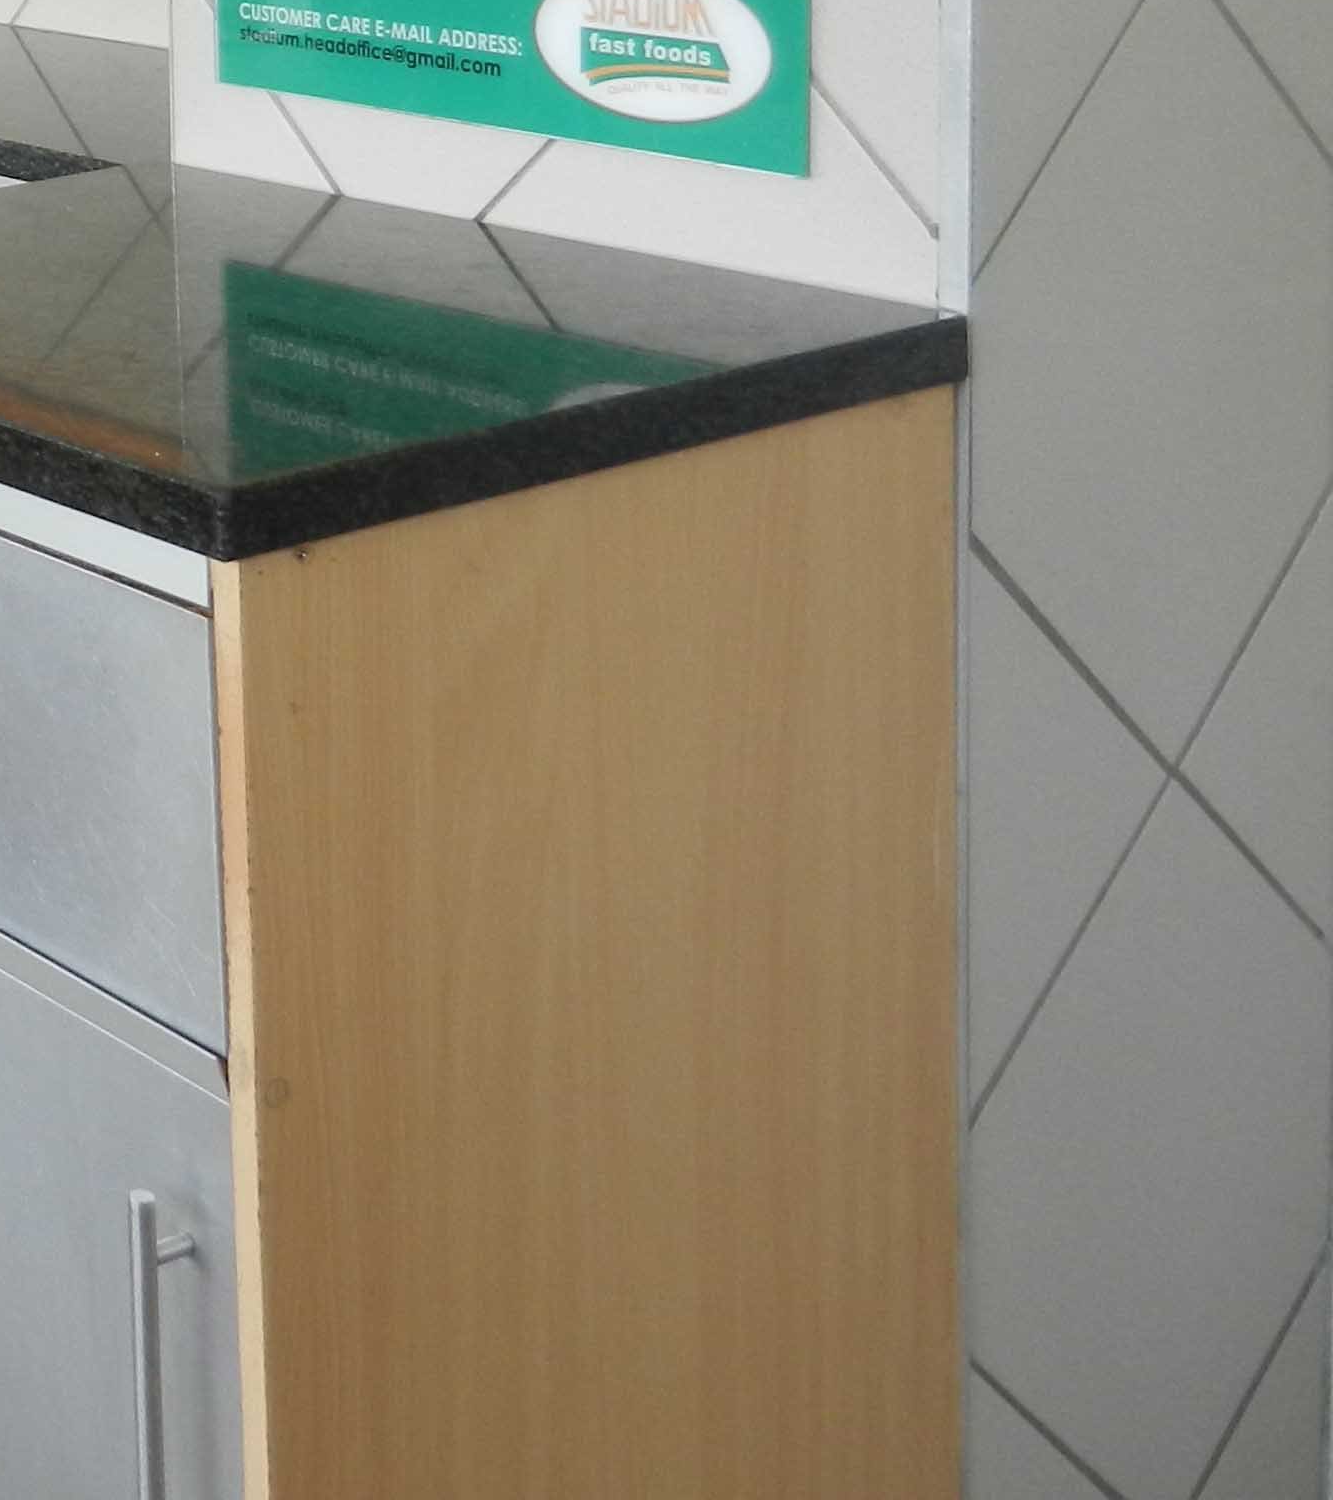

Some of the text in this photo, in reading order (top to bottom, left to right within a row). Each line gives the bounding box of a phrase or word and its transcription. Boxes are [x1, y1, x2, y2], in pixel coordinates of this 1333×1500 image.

[239, 2, 523, 56] CUSTOMER CARE E-MAIL ADDRESS:
[589, 32, 712, 67] fast foods
